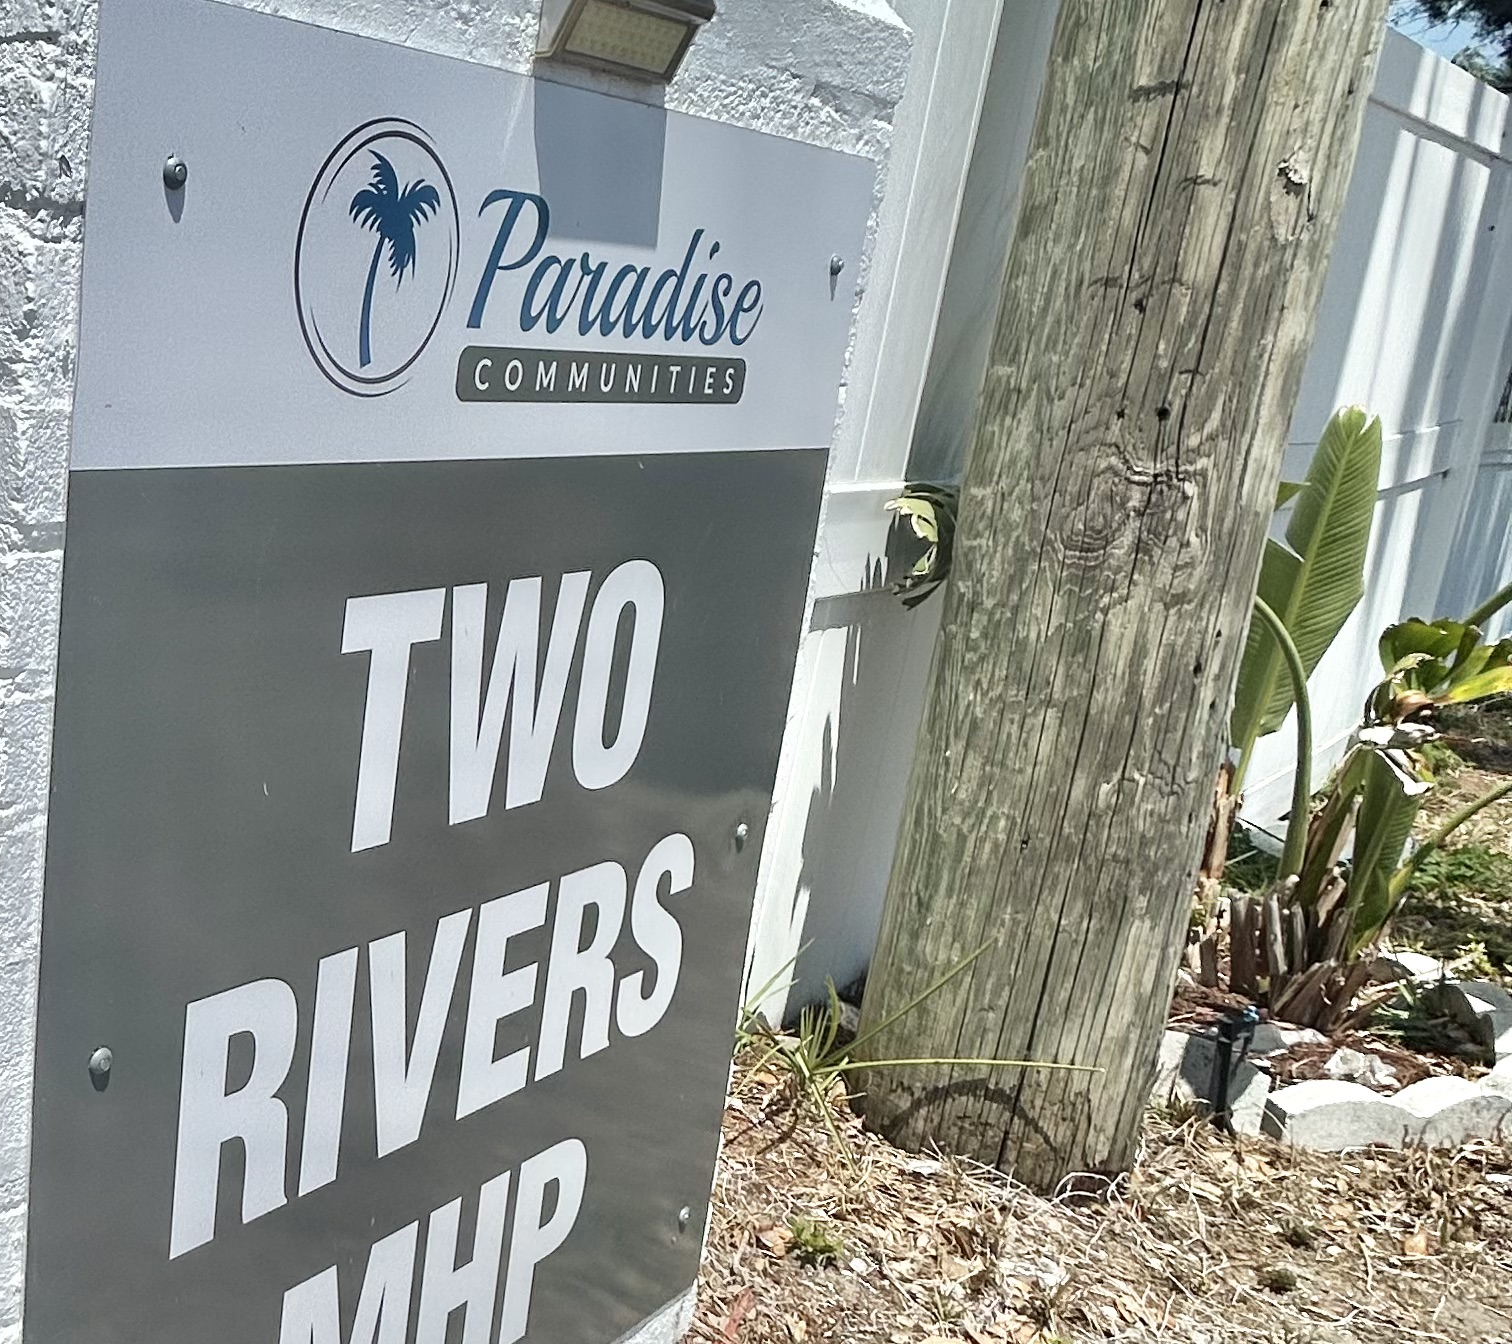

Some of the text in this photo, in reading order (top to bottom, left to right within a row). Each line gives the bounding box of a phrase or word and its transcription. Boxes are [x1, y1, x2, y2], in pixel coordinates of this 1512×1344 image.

[467, 189, 763, 347] Paradise
[473, 357, 737, 397] COMMUNITIES
[341, 558, 666, 853] TWO
[169, 833, 695, 1260] RIVERS
